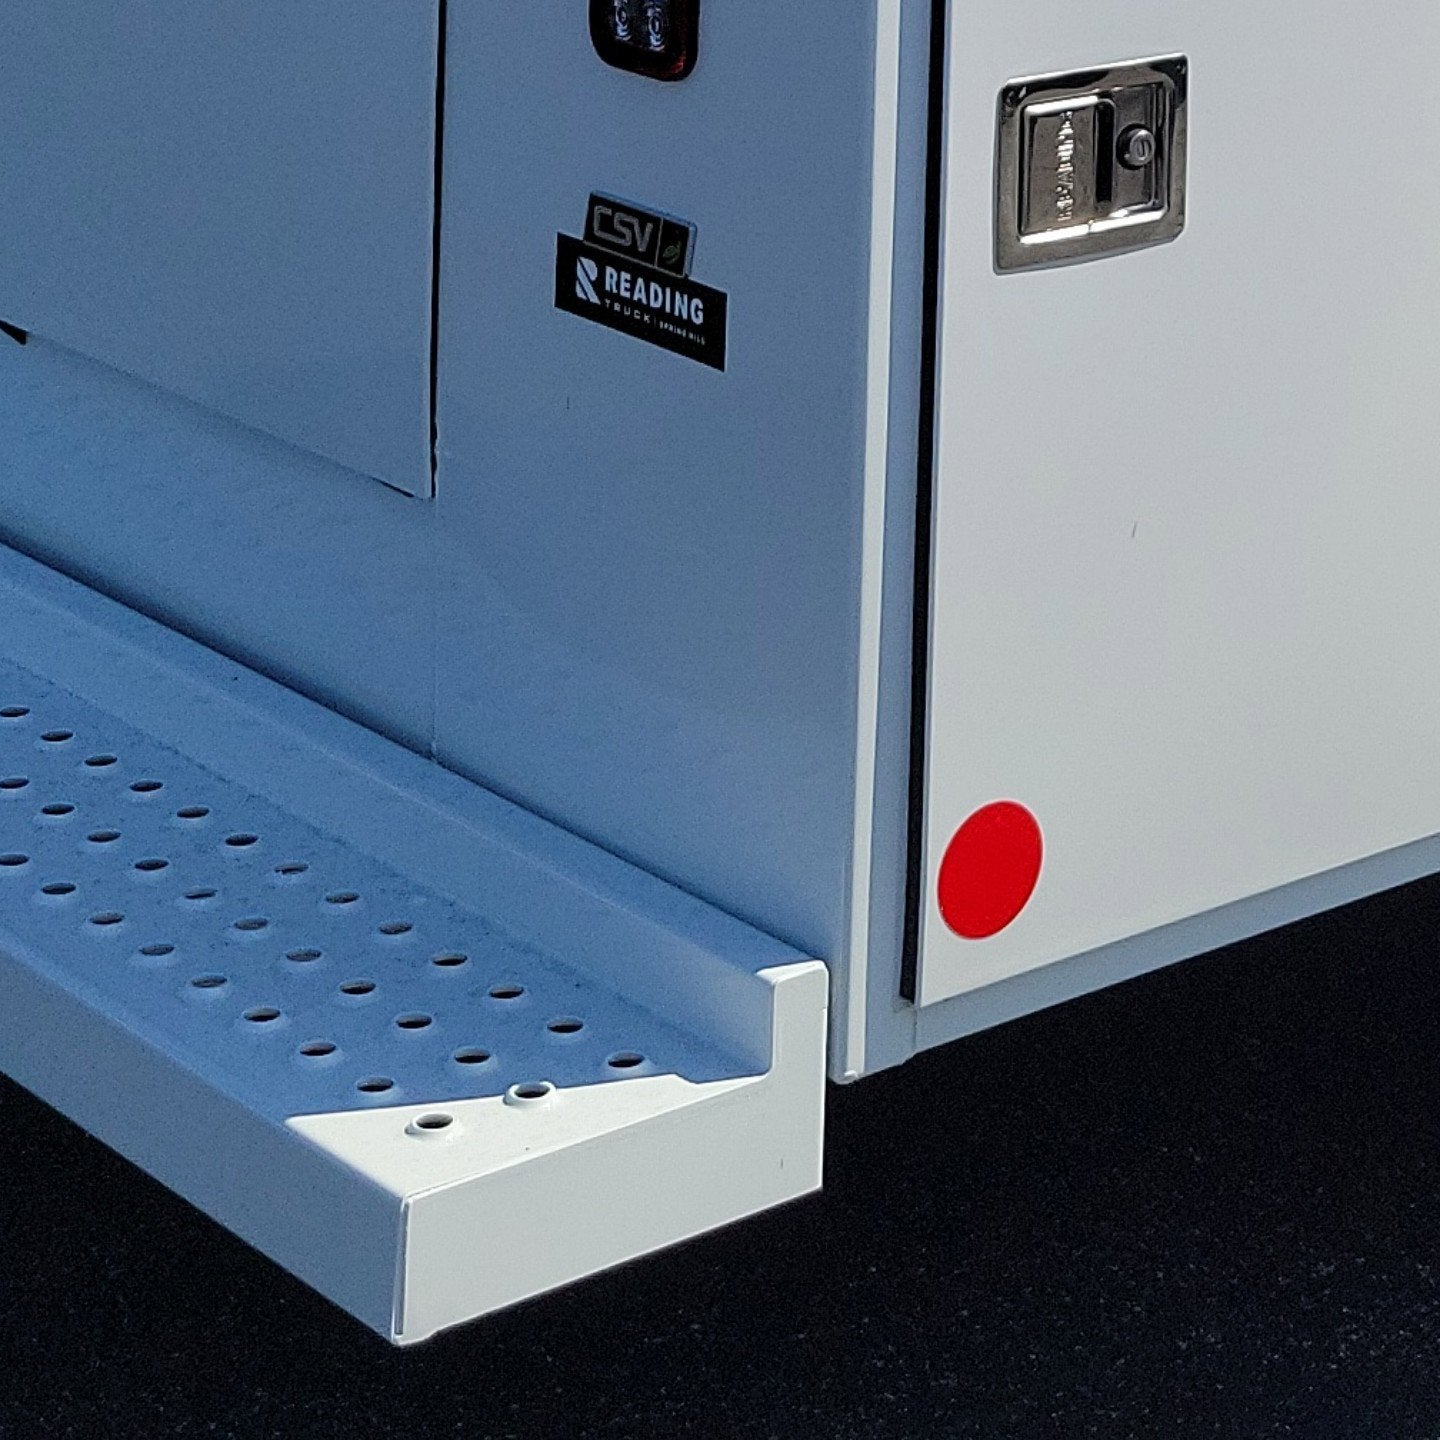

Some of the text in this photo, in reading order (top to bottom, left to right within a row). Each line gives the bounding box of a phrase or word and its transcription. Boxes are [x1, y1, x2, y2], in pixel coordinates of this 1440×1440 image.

[593, 205, 653, 252] CSV
[605, 265, 704, 325] READING
[605, 299, 651, 323] TRUCK
